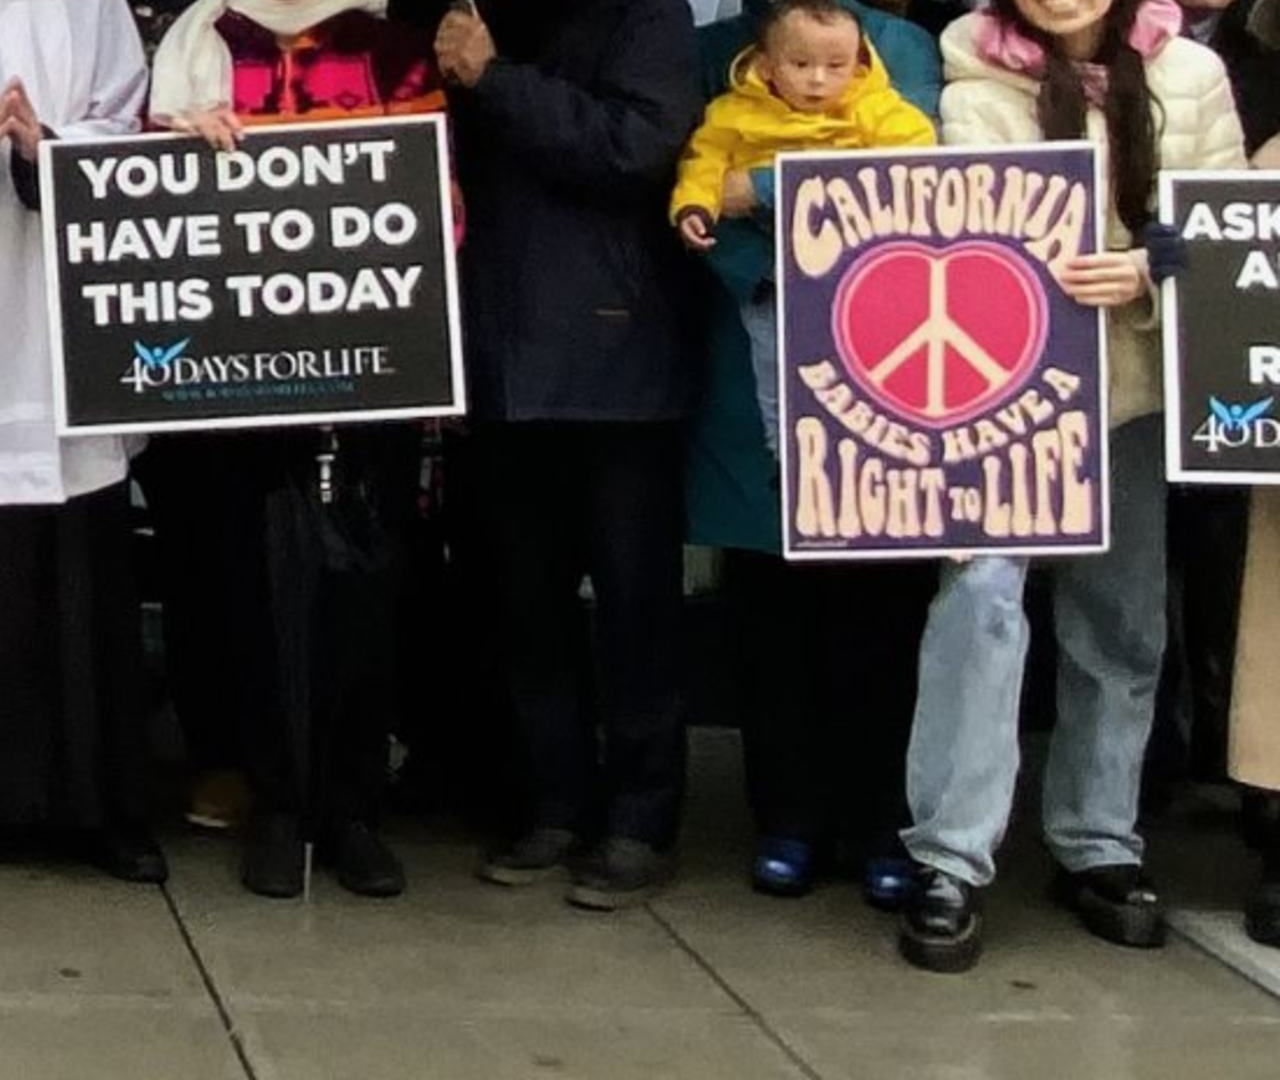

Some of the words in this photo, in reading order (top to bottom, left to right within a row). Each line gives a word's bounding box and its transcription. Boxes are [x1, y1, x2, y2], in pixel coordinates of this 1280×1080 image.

[79, 152, 201, 199] YOU
[214, 141, 396, 191] DON’T
[66, 215, 222, 263] HAVE
[234, 209, 315, 253] TO
[331, 203, 417, 248] DO
[793, 164, 1086, 296] CALIFORNIA
[82, 279, 213, 326] THIS
[226, 266, 423, 318] TODAY
[798, 360, 931, 466] BABIES
[941, 389, 1054, 462] HAVE
[1042, 367, 1081, 401] A
[796, 417, 945, 537] RIGHT
[948, 487, 981, 522] TO
[983, 411, 1092, 537] LIFE
